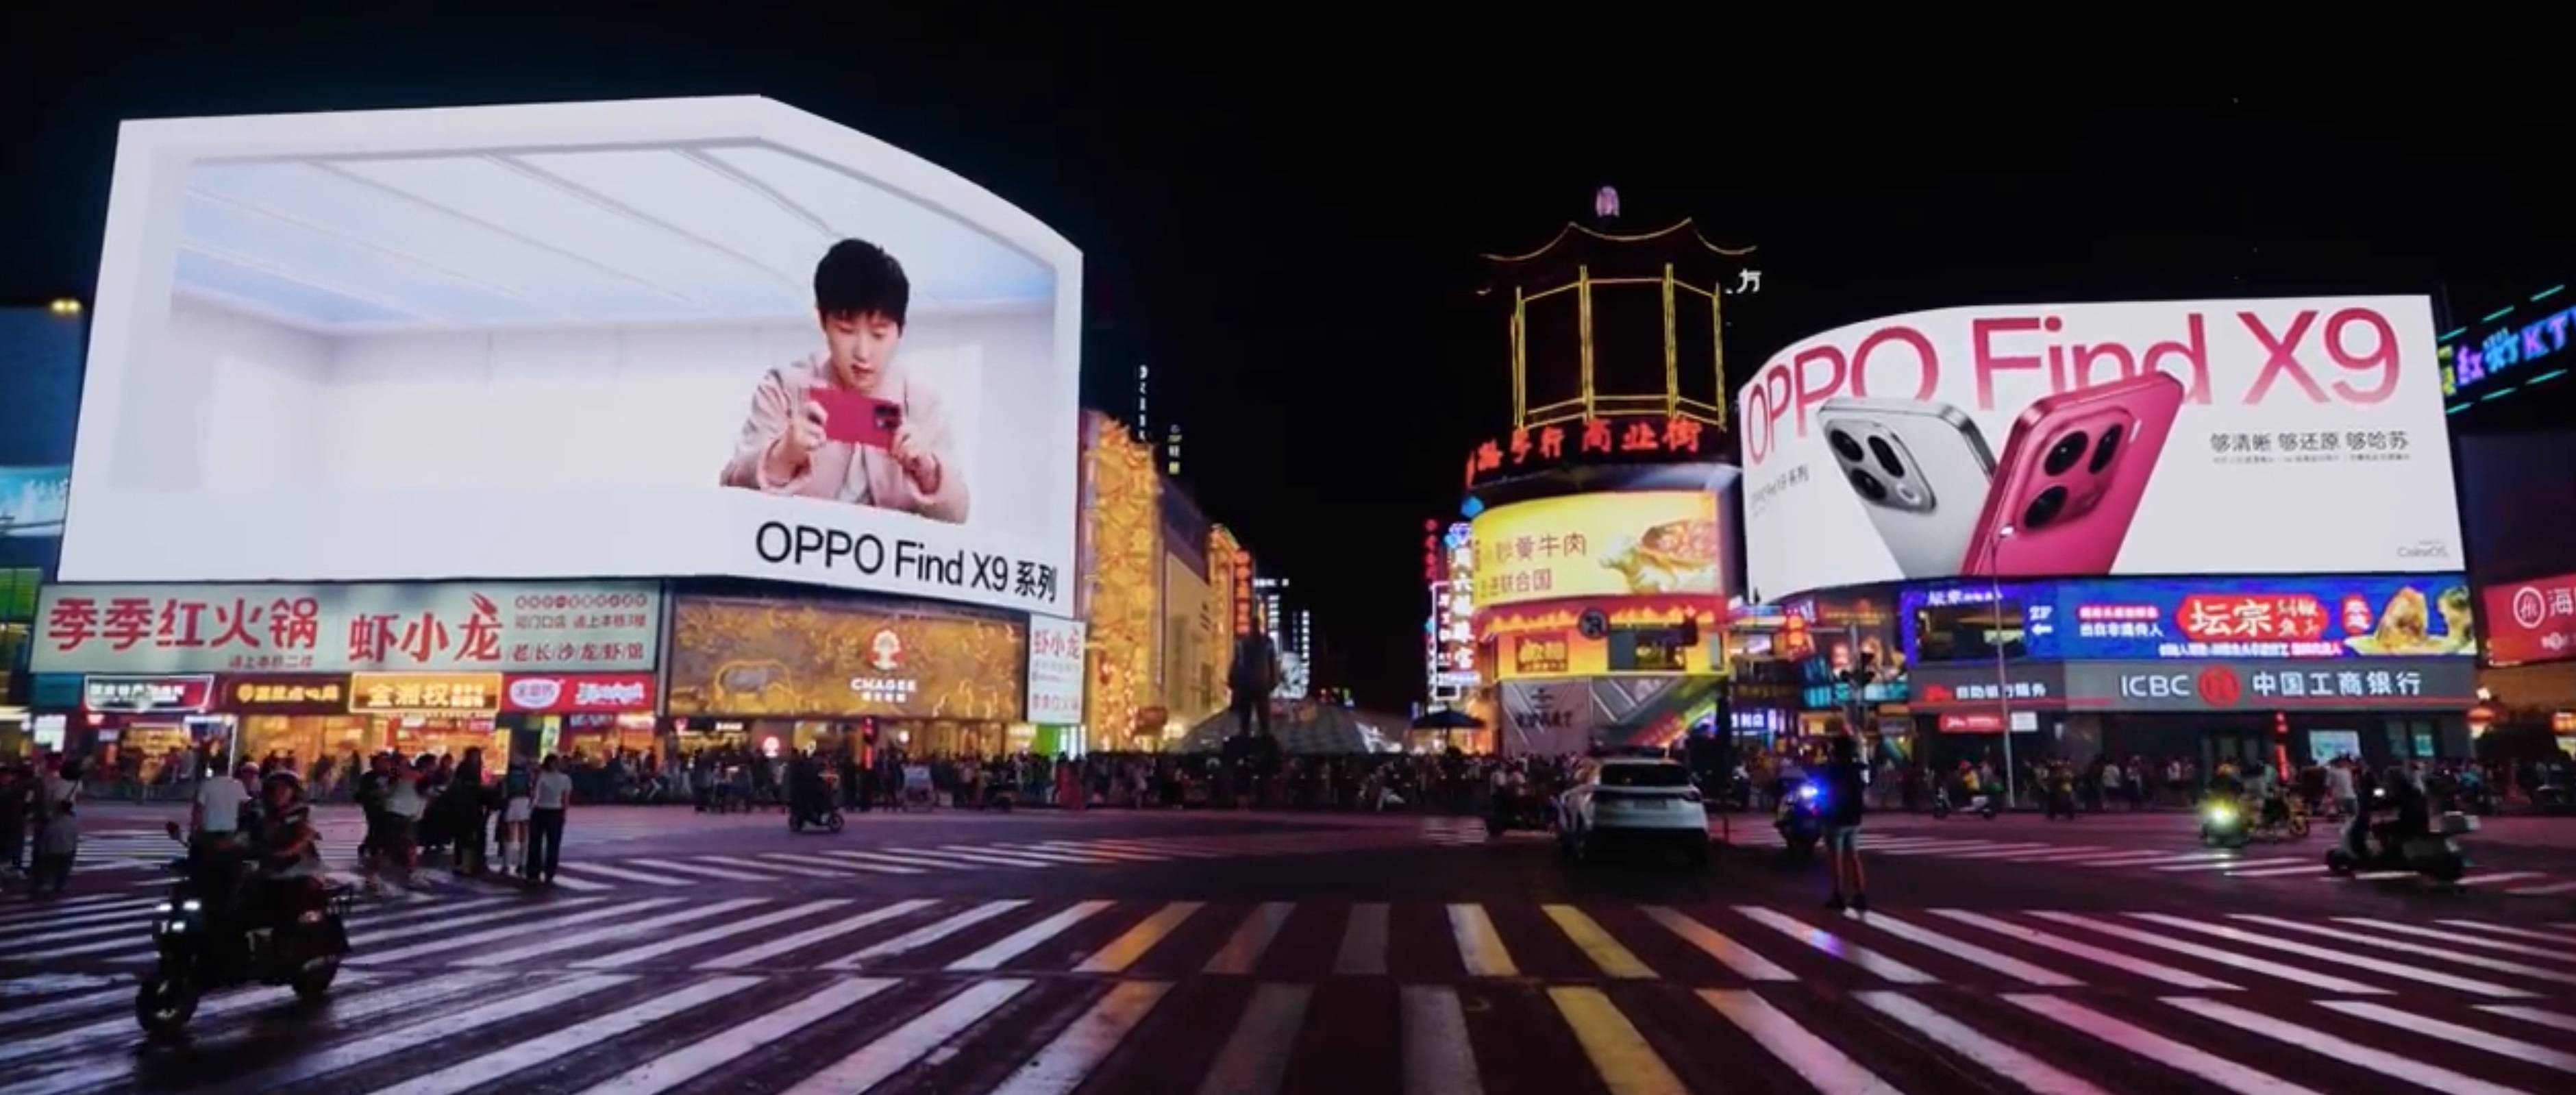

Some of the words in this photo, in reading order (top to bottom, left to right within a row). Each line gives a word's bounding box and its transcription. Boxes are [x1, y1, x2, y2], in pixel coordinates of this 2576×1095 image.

[1746, 325, 1938, 465] OPPO
[1973, 310, 2210, 410] Find
[2237, 308, 2400, 406] X9
[2210, 432, 2272, 453] 够清晰
[2278, 431, 2340, 452] 够还原
[2346, 430, 2410, 450] 够哈苏
[756, 521, 884, 575] OPPO
[895, 540, 963, 587] Find
[971, 551, 1009, 592] X9
[1014, 558, 1057, 603] 系列
[2189, 599, 2272, 637] 坛宗
[2546, 586, 2576, 618] 海
[48, 597, 319, 651] 季季红火锅
[348, 608, 504, 663] 虾小龙
[850, 678, 917, 693] CHAGEE
[2120, 675, 2191, 698] ICBC
[2252, 671, 2422, 697] 中国工商银行
